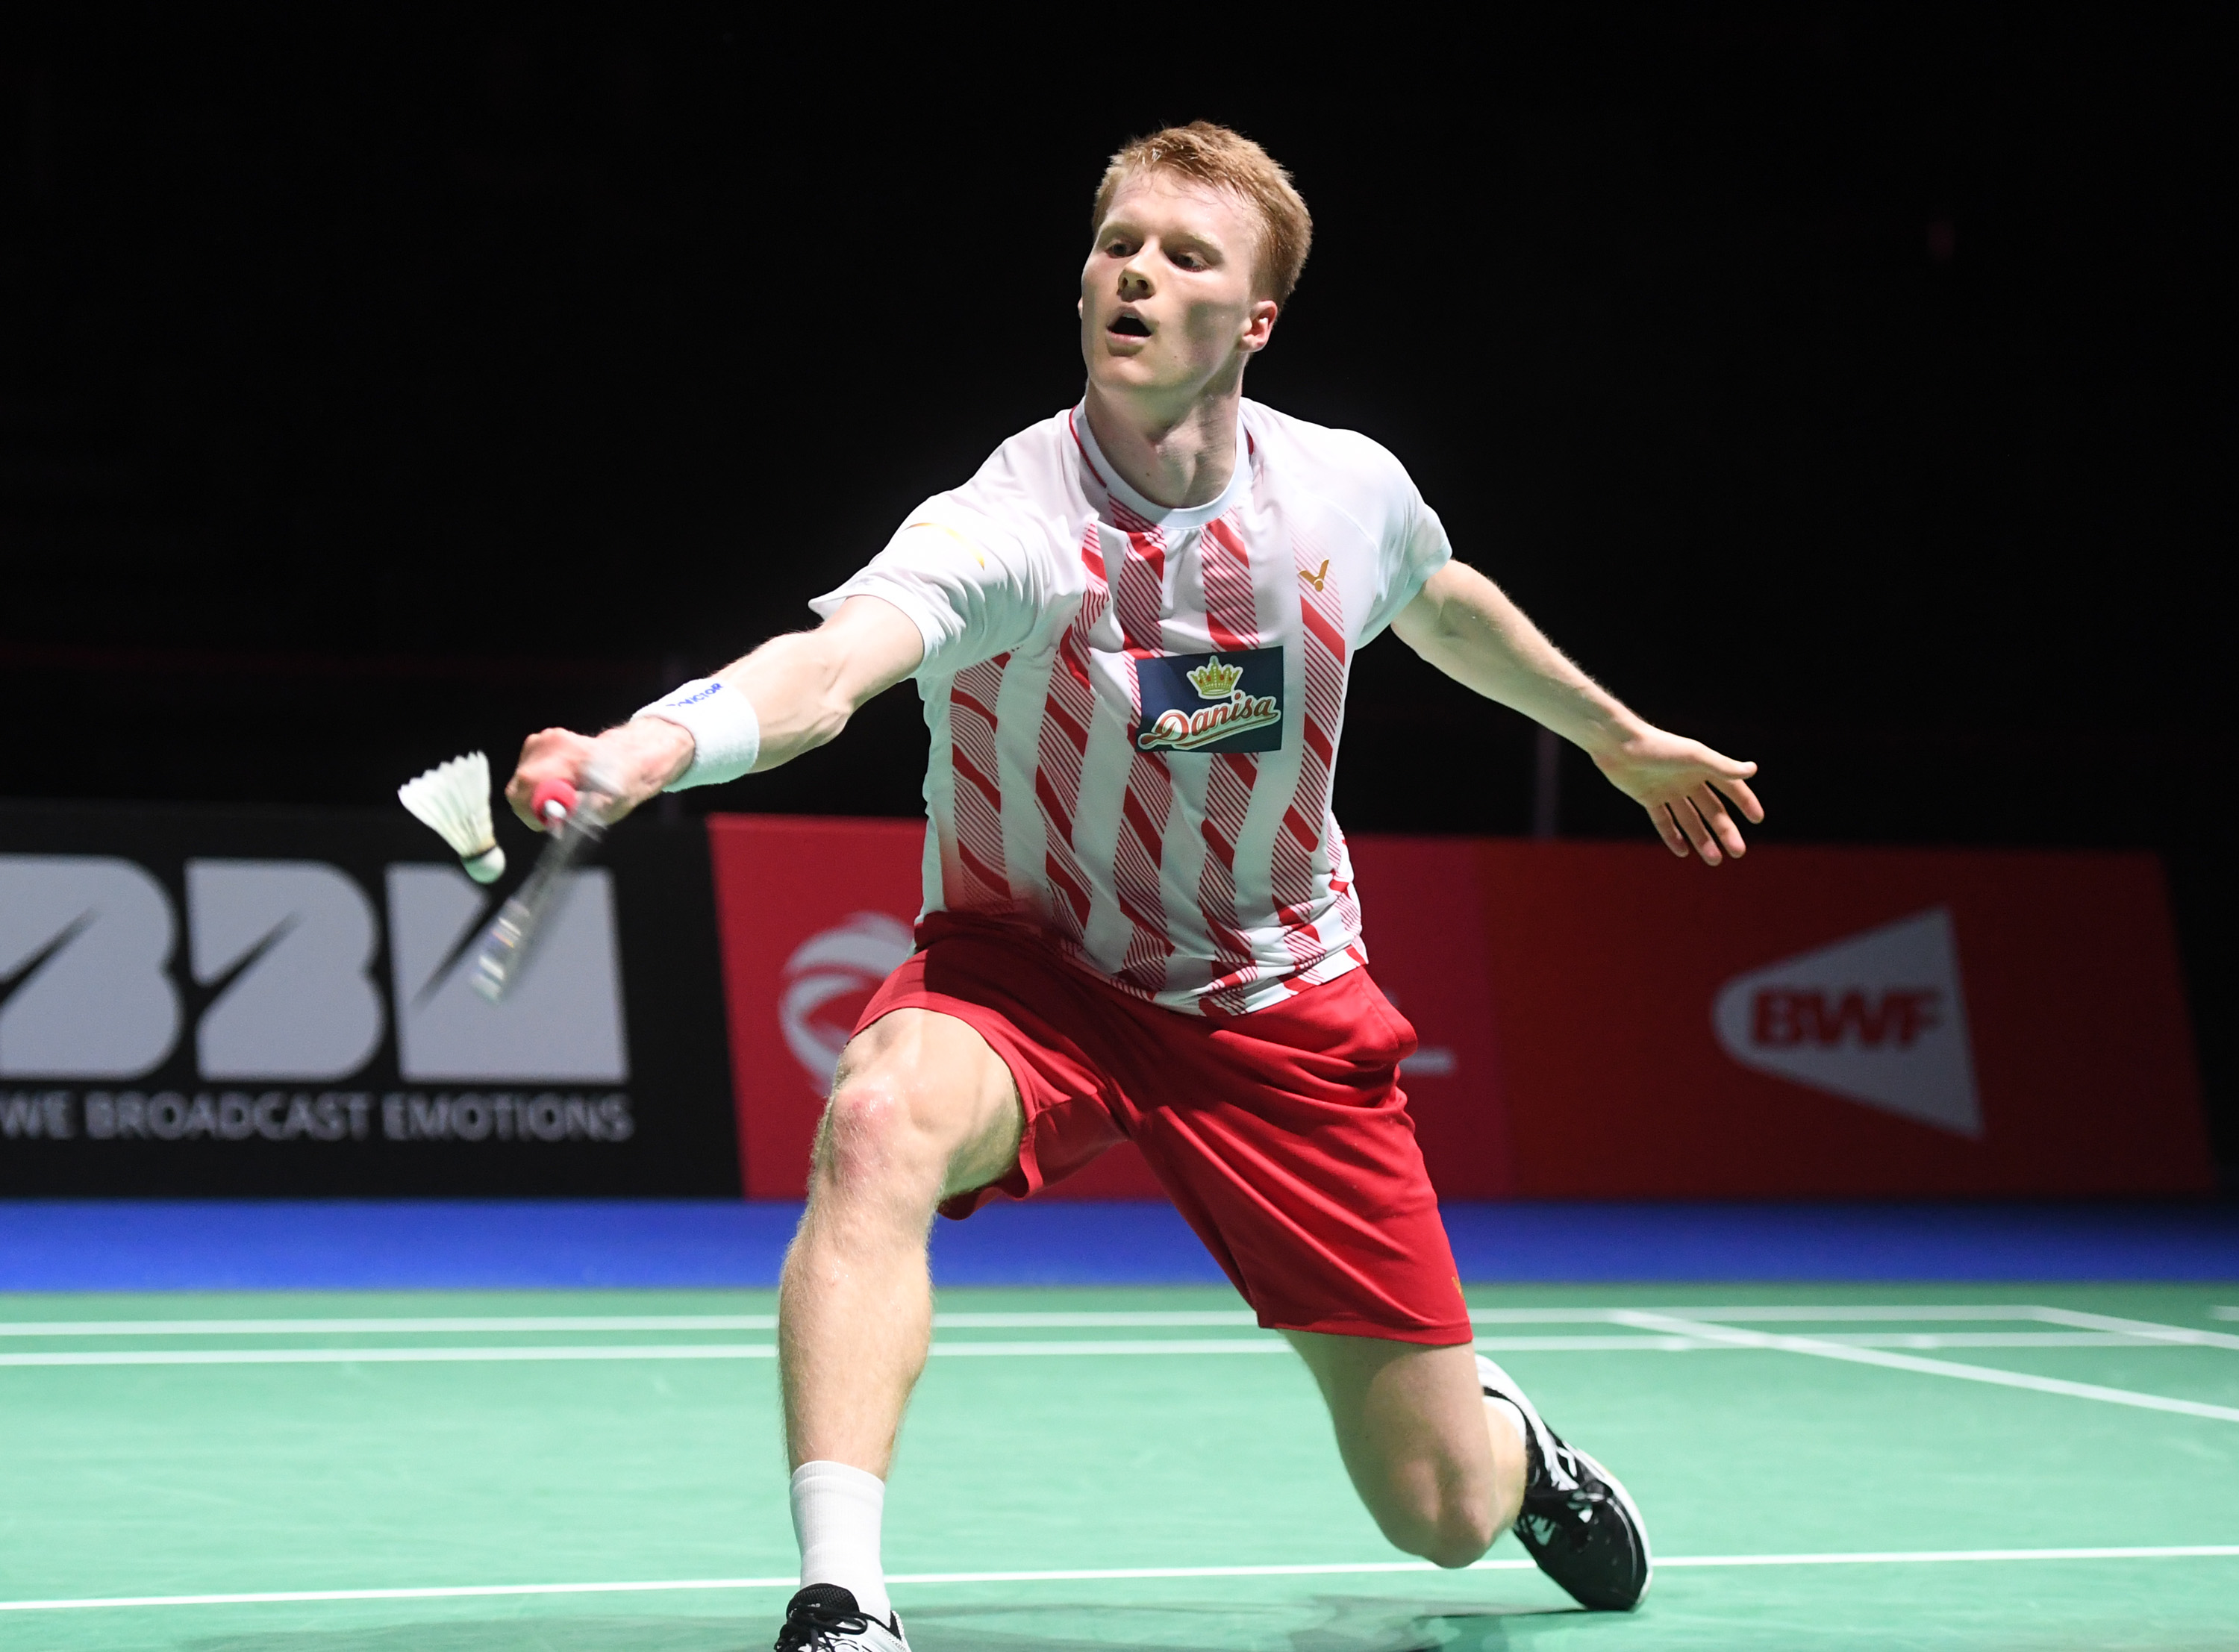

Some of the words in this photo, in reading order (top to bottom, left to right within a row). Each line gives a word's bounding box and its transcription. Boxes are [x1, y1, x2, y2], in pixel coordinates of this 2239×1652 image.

[1138, 691, 1279, 748] Danisa
[1752, 986, 1942, 1049] BWF
[0, 1089, 72, 1139] WE
[85, 1091, 372, 1140] BROADCAST
[384, 1092, 634, 1142] EMOTIONS
